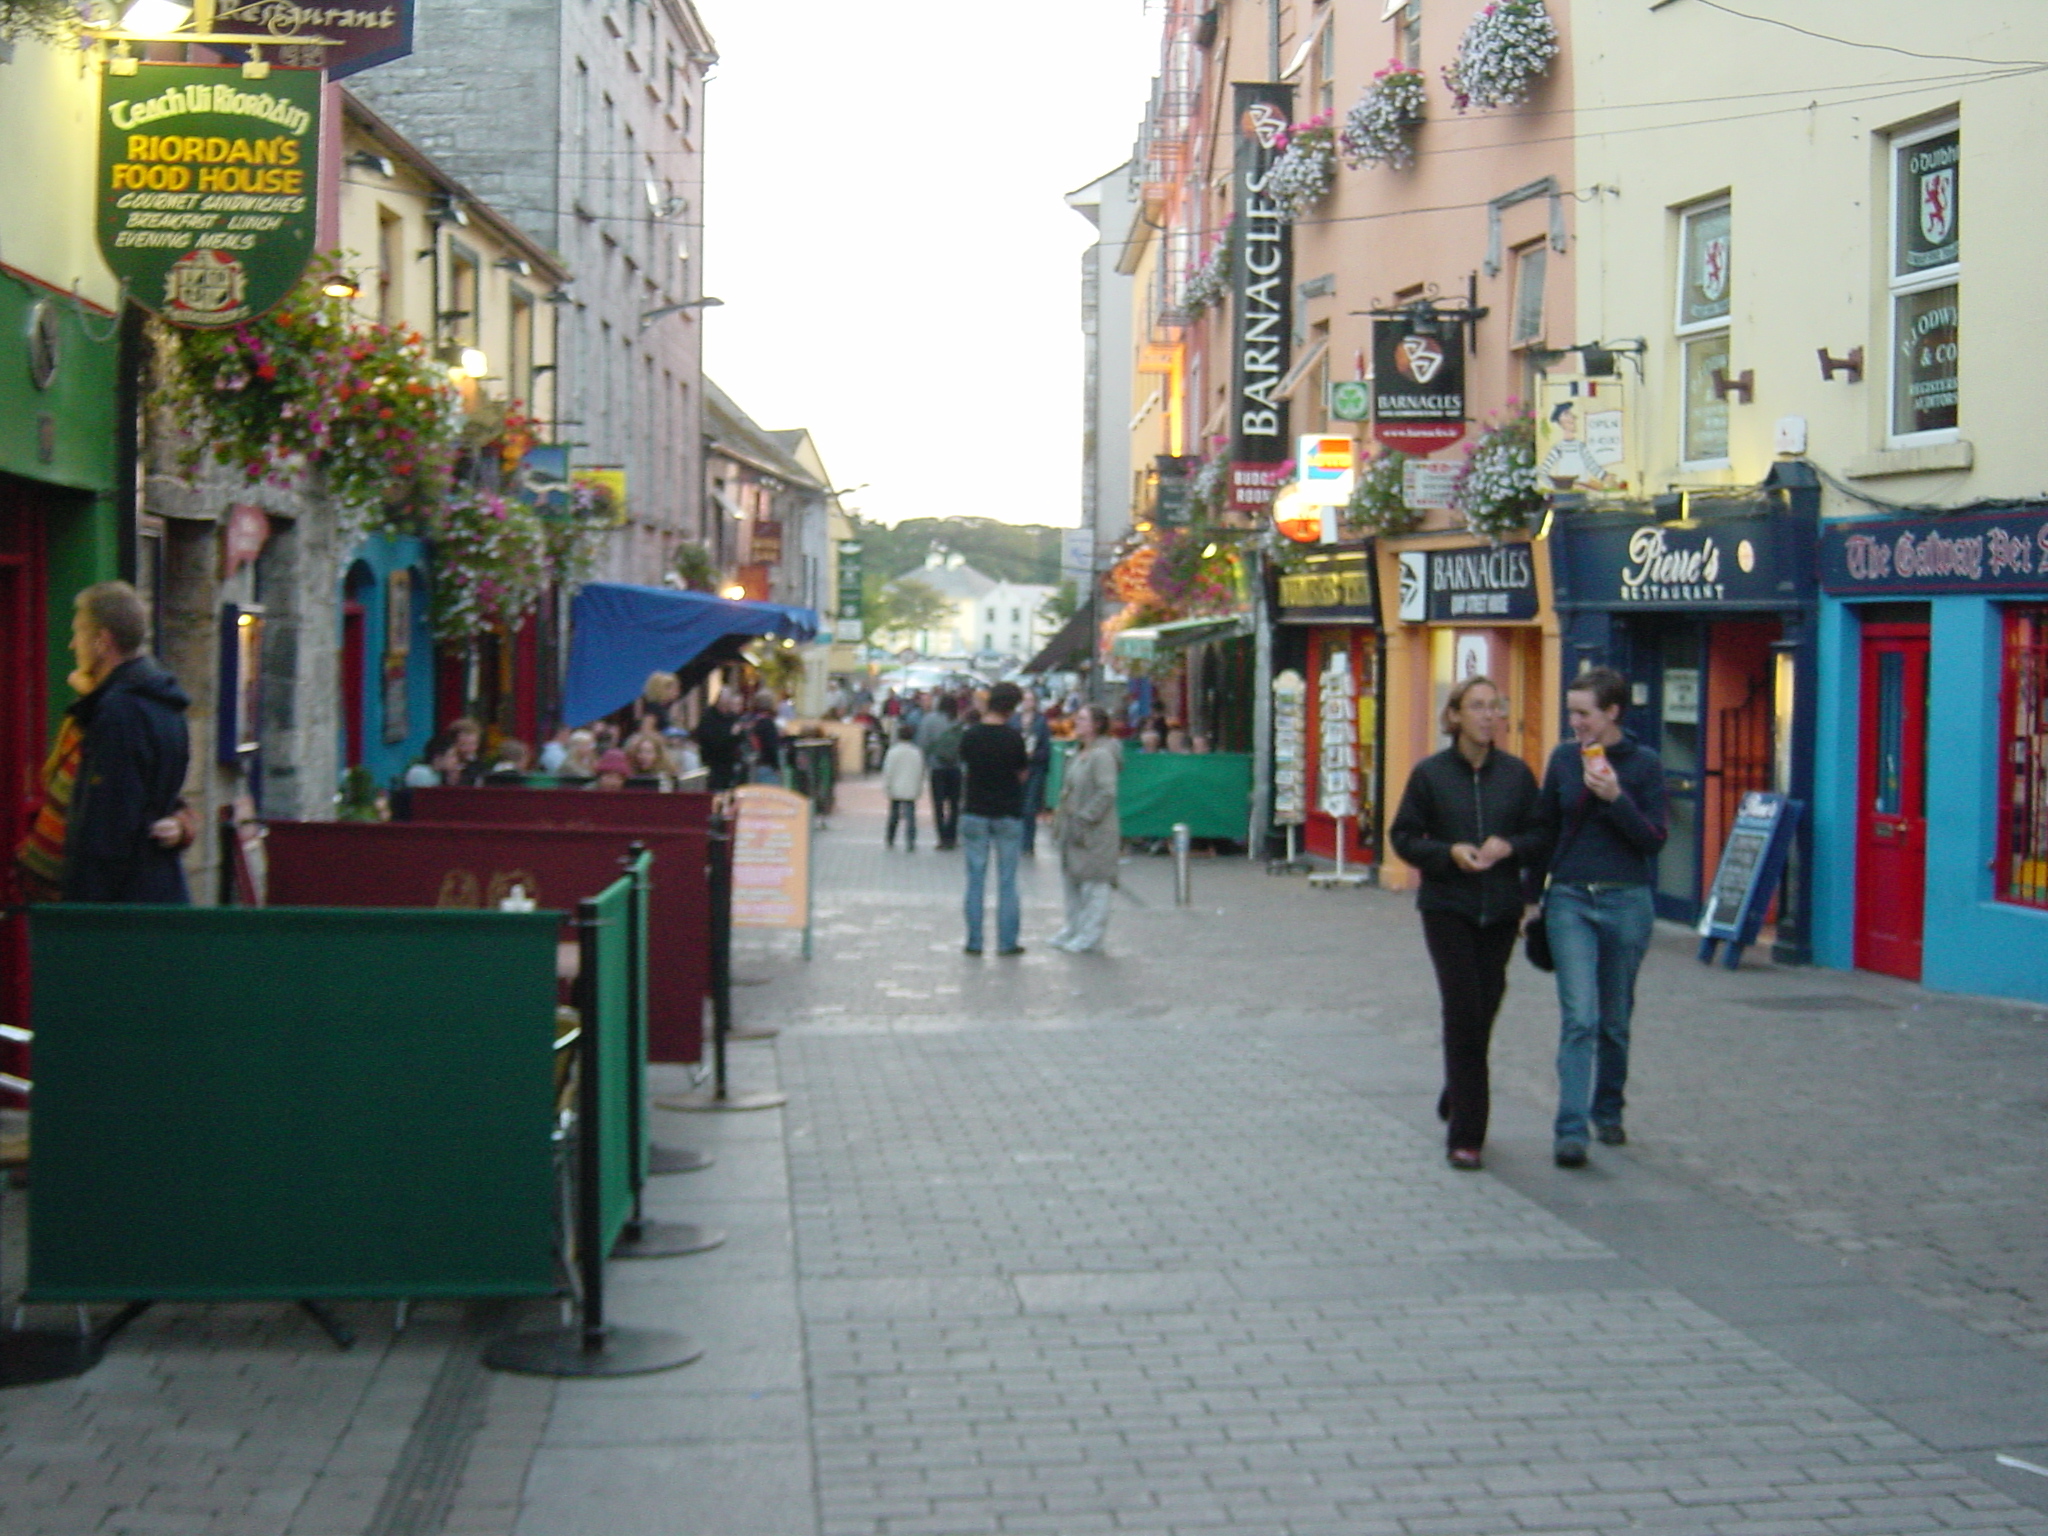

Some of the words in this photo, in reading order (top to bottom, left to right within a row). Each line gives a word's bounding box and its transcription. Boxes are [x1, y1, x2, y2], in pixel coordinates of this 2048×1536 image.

[126, 134, 300, 166] RIORDAN'S
[111, 163, 192, 192] FOOD
[198, 167, 304, 194] HOUSE
[116, 193, 201, 210] GOURMET
[200, 195, 308, 213] SANDWICHES
[126, 212, 221, 229] BREAKFAST
[227, 215, 284, 231] LUNCH
[115, 230, 193, 249] EVENING
[195, 232, 257, 250] MEALS
[1242, 172, 1283, 437] BARNACLES
[1377, 394, 1461, 410] BARNACLES
[1622, 526, 1719, 587] Pierre's
[1845, 534, 1891, 580] The
[1987, 526, 2032, 577] Pet
[1433, 547, 1529, 591] BARNACLES
[1620, 583, 1725, 600] RESTAURANT
